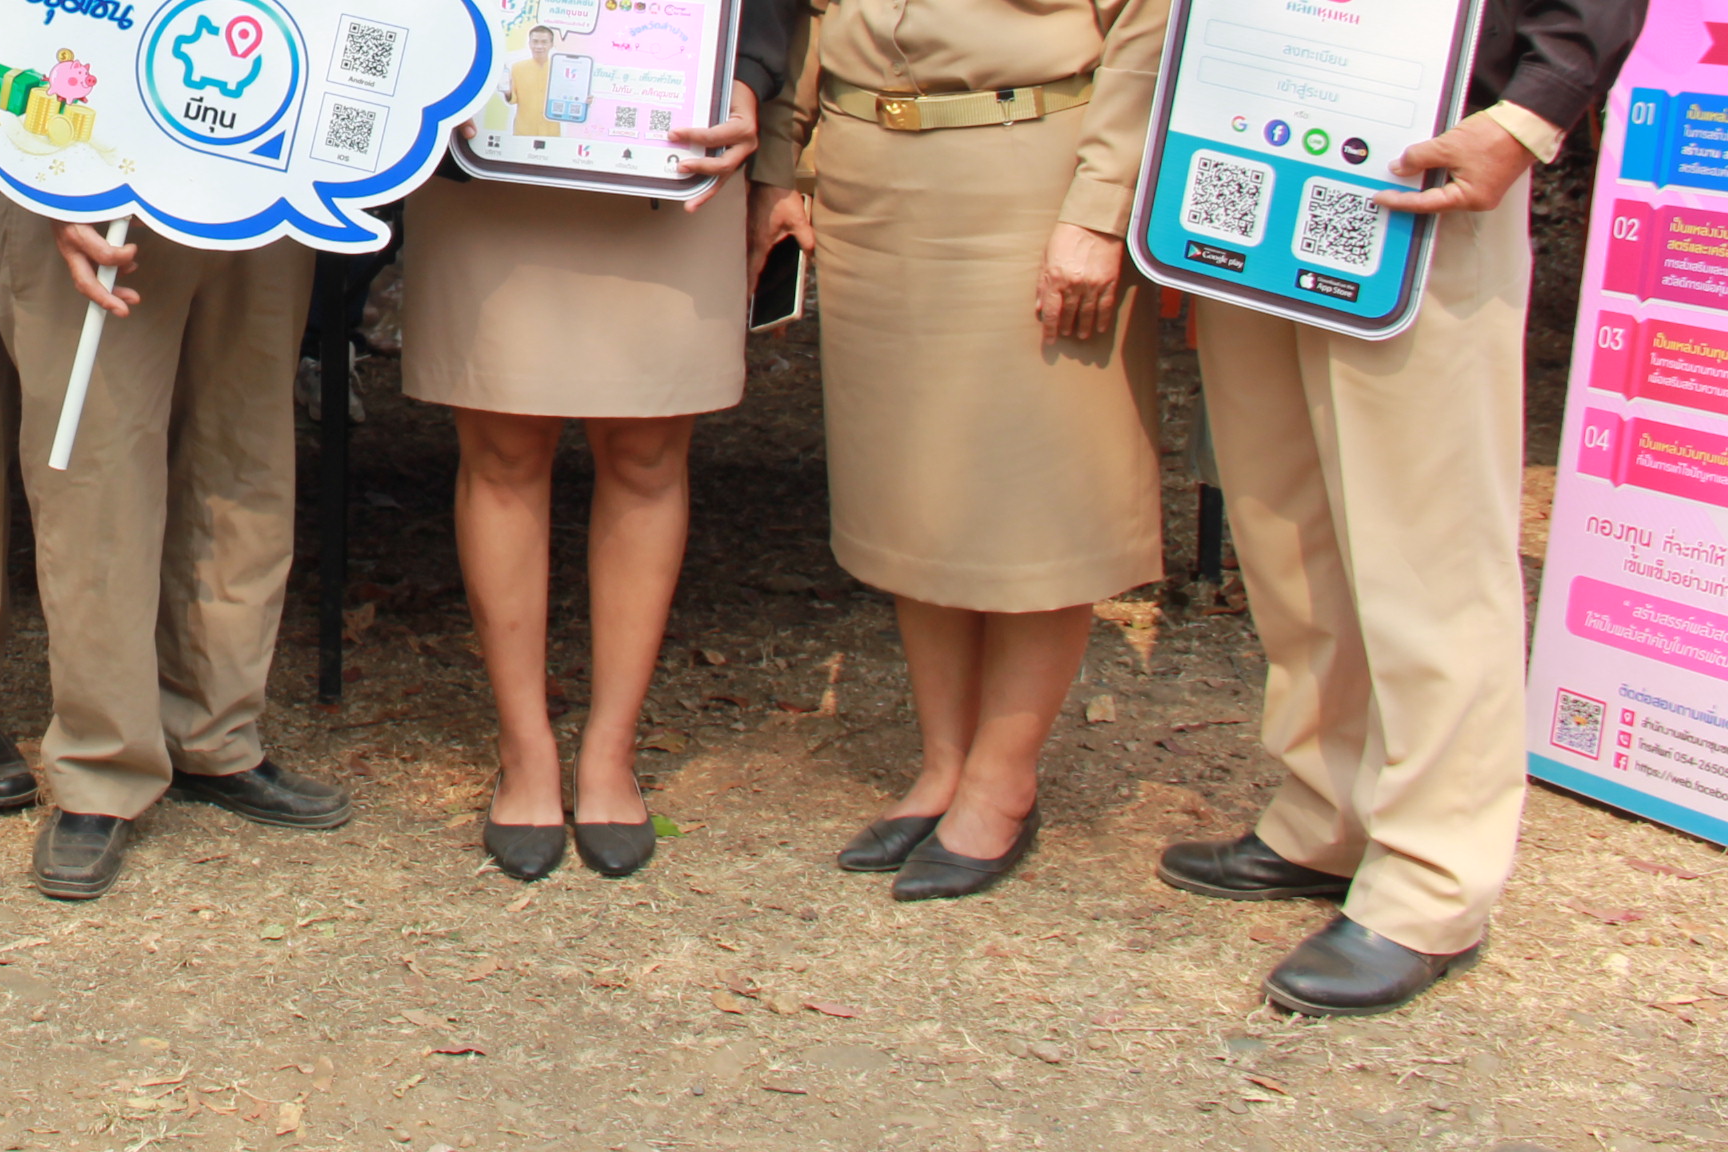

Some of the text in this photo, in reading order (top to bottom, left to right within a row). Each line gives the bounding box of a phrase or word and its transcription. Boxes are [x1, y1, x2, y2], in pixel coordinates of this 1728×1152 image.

[1286, 0, 1360, 24] คลิกชุมชน
[1282, 45, 1348, 67] ลงทะเบียน
[348, 76, 375, 88] Android
[1276, 79, 1339, 102] เข้าสู่ระบบ
[183, 96, 237, 134] มีทุน
[1631, 101, 1656, 126] 01
[1613, 216, 1640, 242] 02
[1202, 251, 1228, 264] Google
[1598, 326, 1625, 350] 03
[1584, 425, 1610, 451] 04
[1586, 515, 1652, 553] กองทุน
